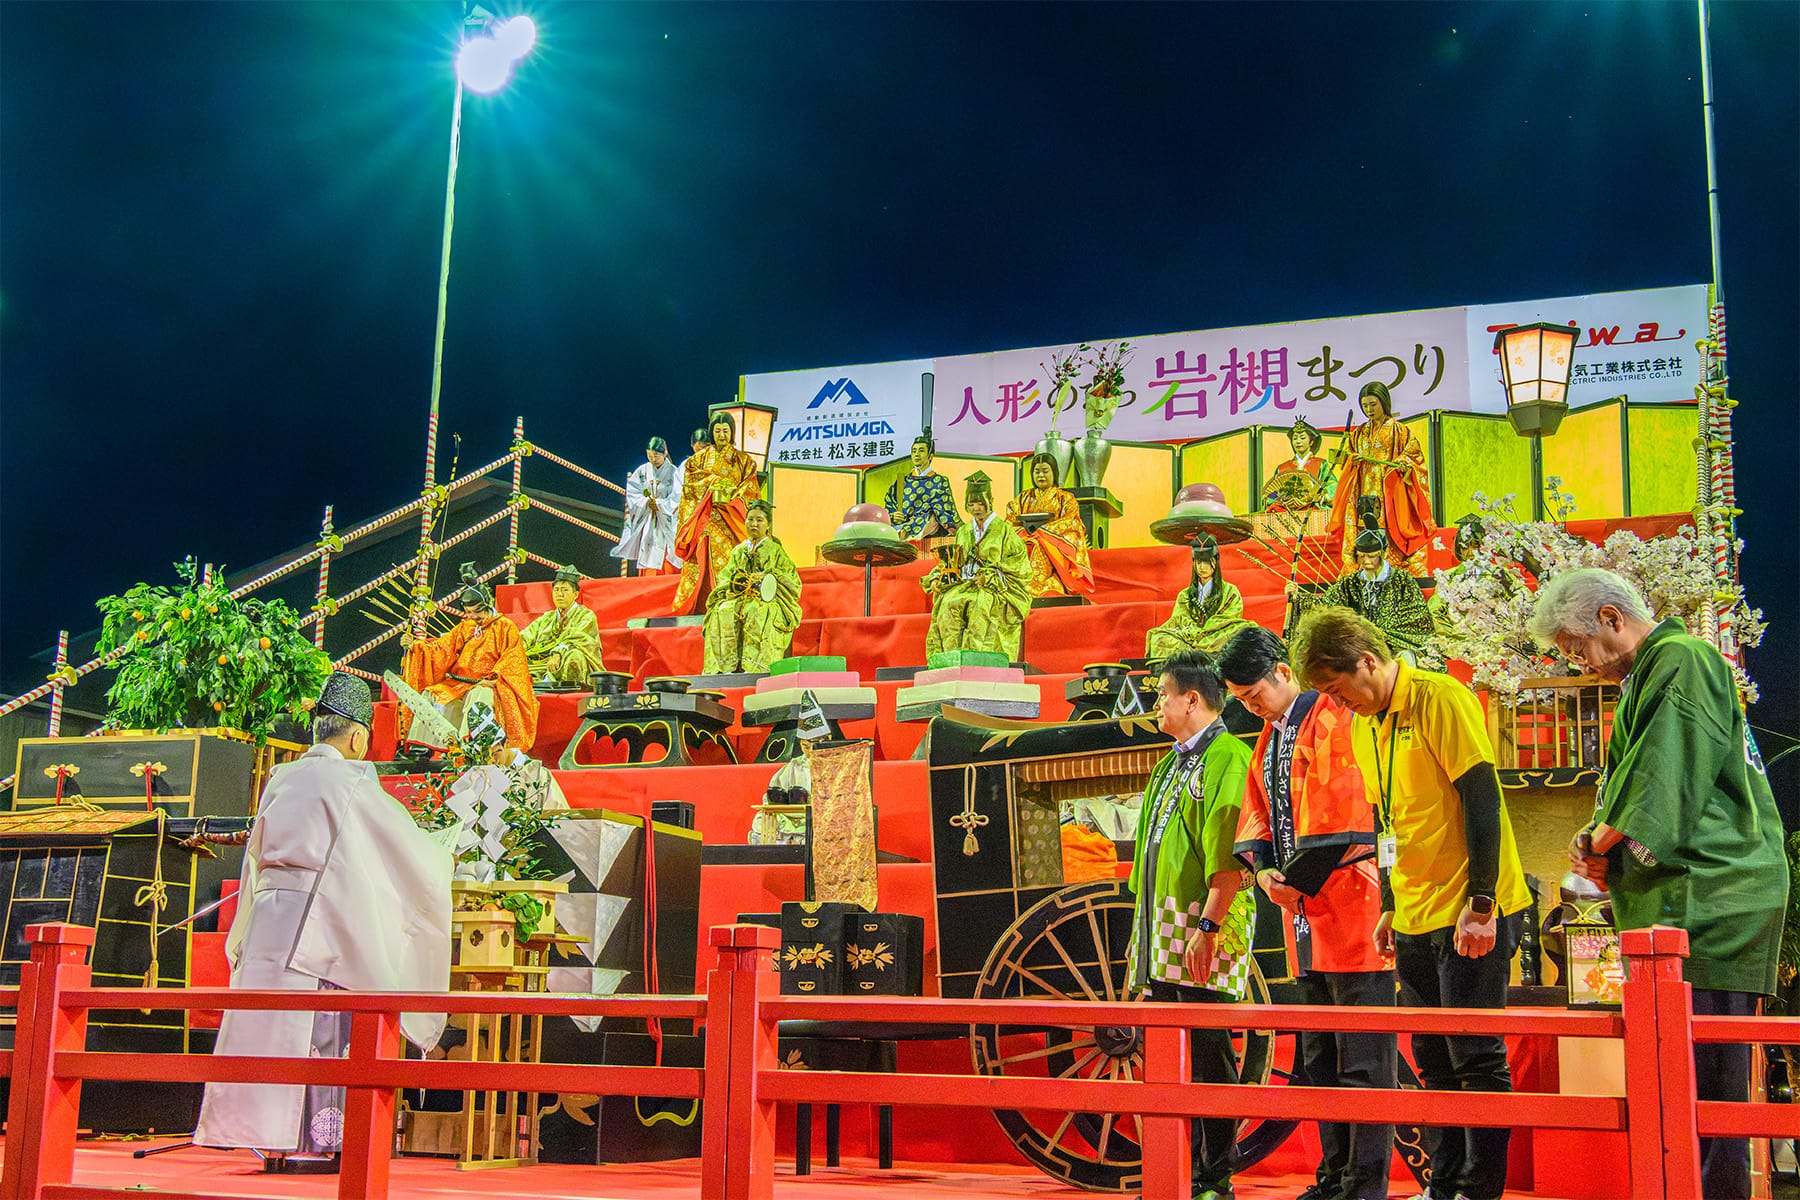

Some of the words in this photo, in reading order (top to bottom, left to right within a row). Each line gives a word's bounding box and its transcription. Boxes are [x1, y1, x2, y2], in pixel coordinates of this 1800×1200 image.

[1570, 356, 1682, 377] 気工業株式会社
[1599, 373, 1647, 382] INDUSTRIES
[780, 420, 895, 443] MATSUNAGA
[778, 447, 823, 461] 株式会社
[828, 439, 895, 460] 松永建設
